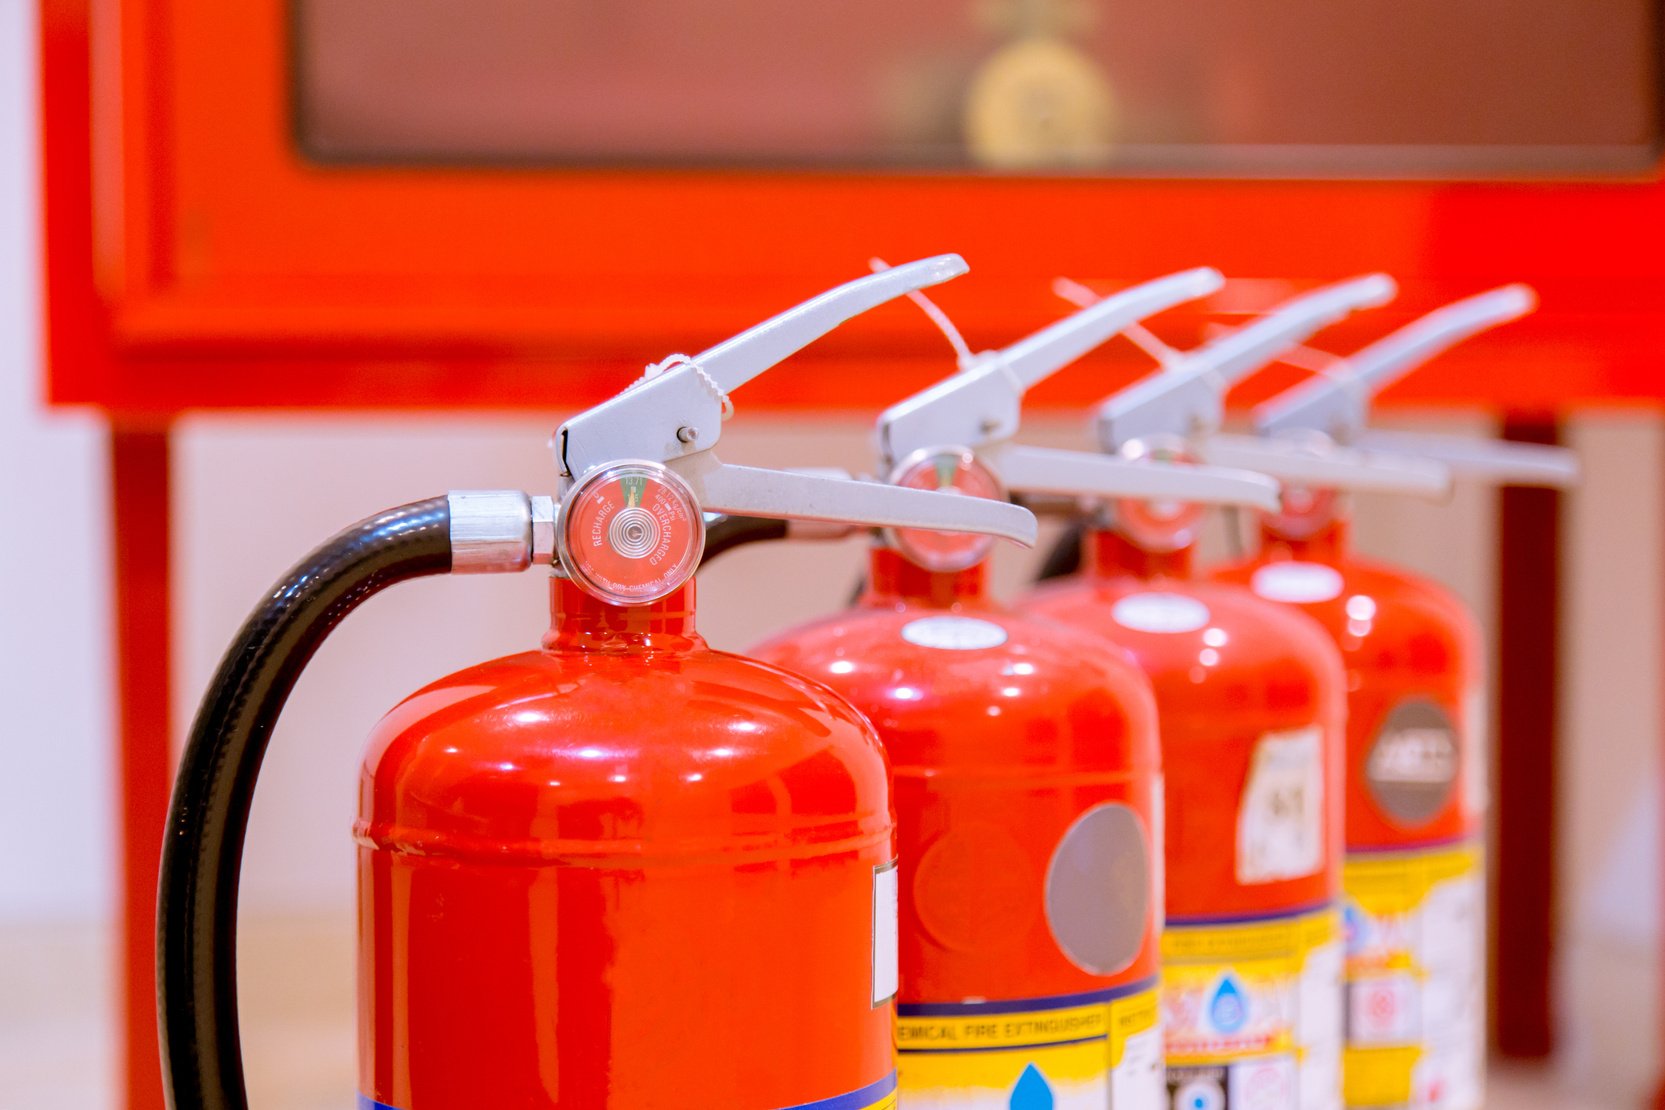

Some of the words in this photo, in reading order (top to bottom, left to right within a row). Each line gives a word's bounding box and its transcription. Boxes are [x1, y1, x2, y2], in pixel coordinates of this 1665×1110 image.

[592, 501, 615, 547] RECHARGE
[649, 503, 672, 566] OVERCHARGED
[897, 1026, 957, 1041] EMICAL
[964, 1023, 998, 1039] FIRE
